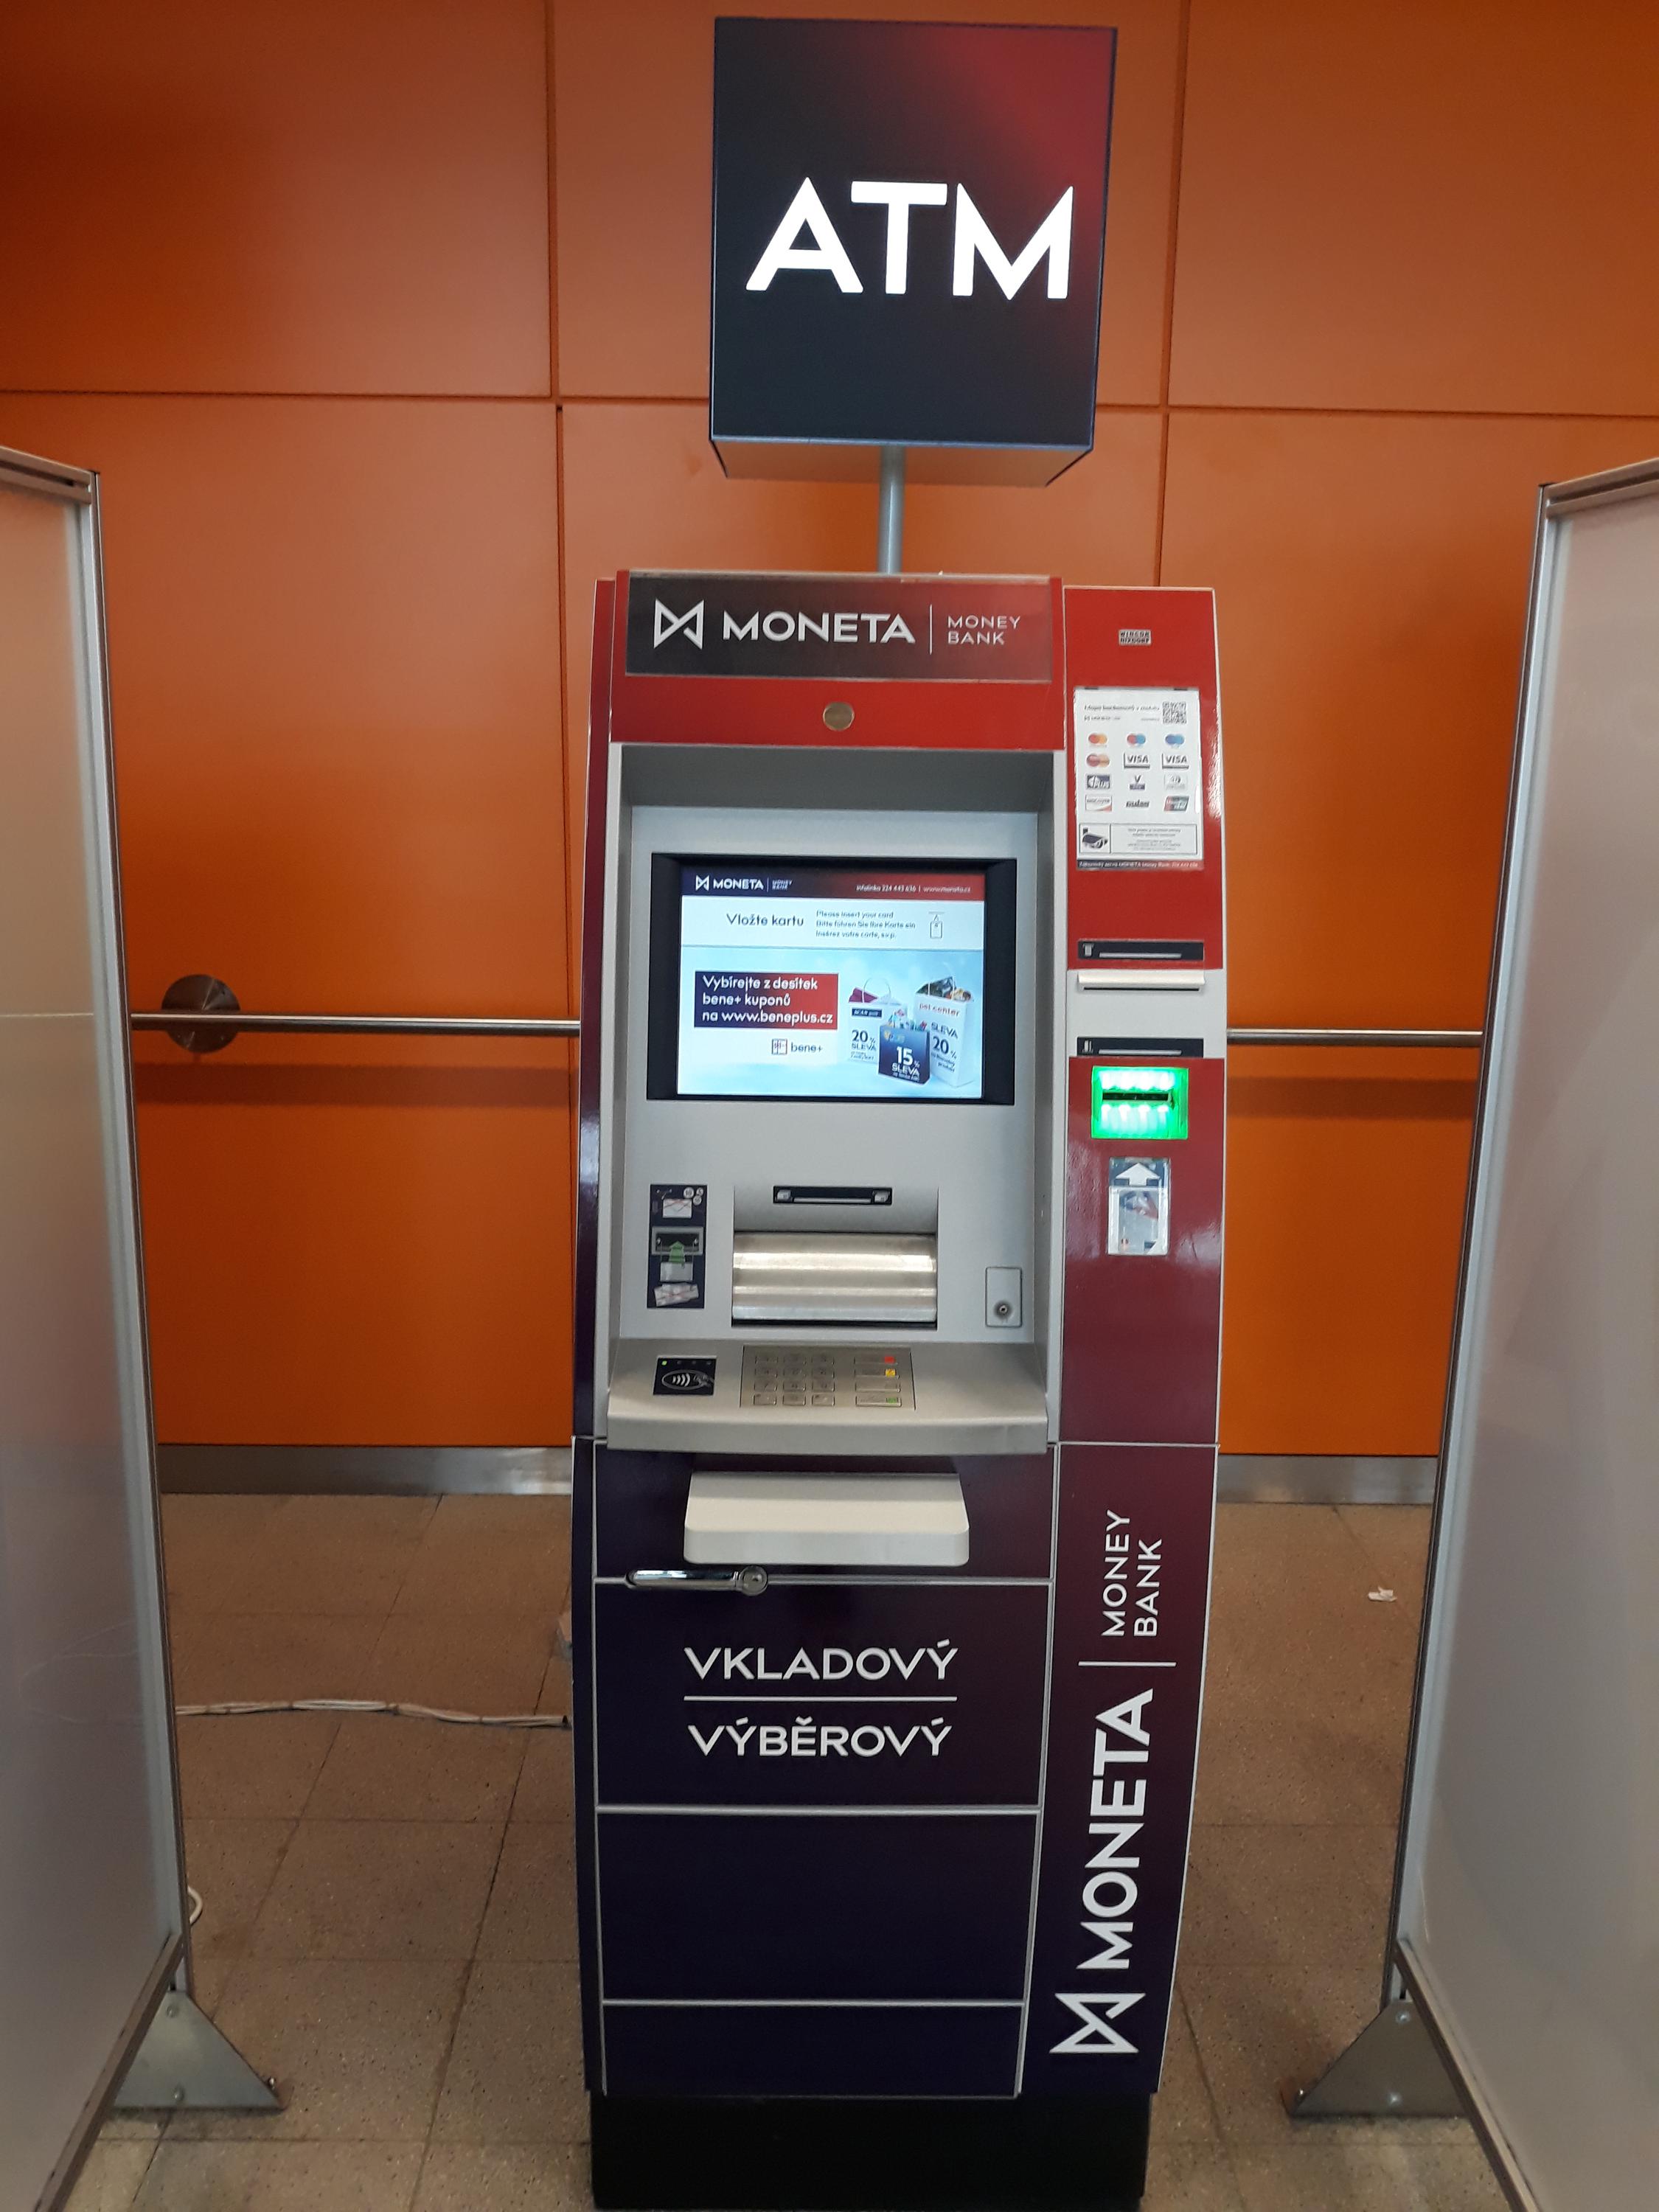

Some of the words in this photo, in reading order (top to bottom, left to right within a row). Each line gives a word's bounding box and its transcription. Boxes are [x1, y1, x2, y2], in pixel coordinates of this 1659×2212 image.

[745, 176, 1074, 300] ATM
[723, 610, 916, 644] MONETA
[947, 615, 1022, 630] MONEY
[947, 630, 1005, 646] BANK
[1127, 754, 1149, 763] VISA
[1166, 755, 1187, 763] VISA
[713, 877, 764, 890] MONETA
[726, 913, 768, 926] Vložte
[772, 914, 804, 926] kartu
[702, 975, 760, 992] Vybírejte
[763, 979, 771, 990] z
[773, 976, 818, 990] desítek
[702, 992, 742, 1005] bene+
[744, 992, 790, 1009] kuponů
[702, 1011, 717, 1022] na
[721, 1010, 833, 1026] www.beneplus.cz
[852, 1029, 869, 1043] 20
[931, 1022, 959, 1040] SLEVA
[791, 1042, 823, 1053] bene+
[933, 1036, 949, 1054] 20
[896, 1046, 914, 1065] 15
[891, 1062, 921, 1076] SLEVA
[1100, 1510, 1131, 1637] MONEY
[1133, 1540, 1163, 1637] BANK
[684, 1638, 959, 1680] VKLADOVÝ
[687, 1716, 953, 1757] VÝBĚROVÝ
[1076, 1688, 1154, 1970] MONETA
